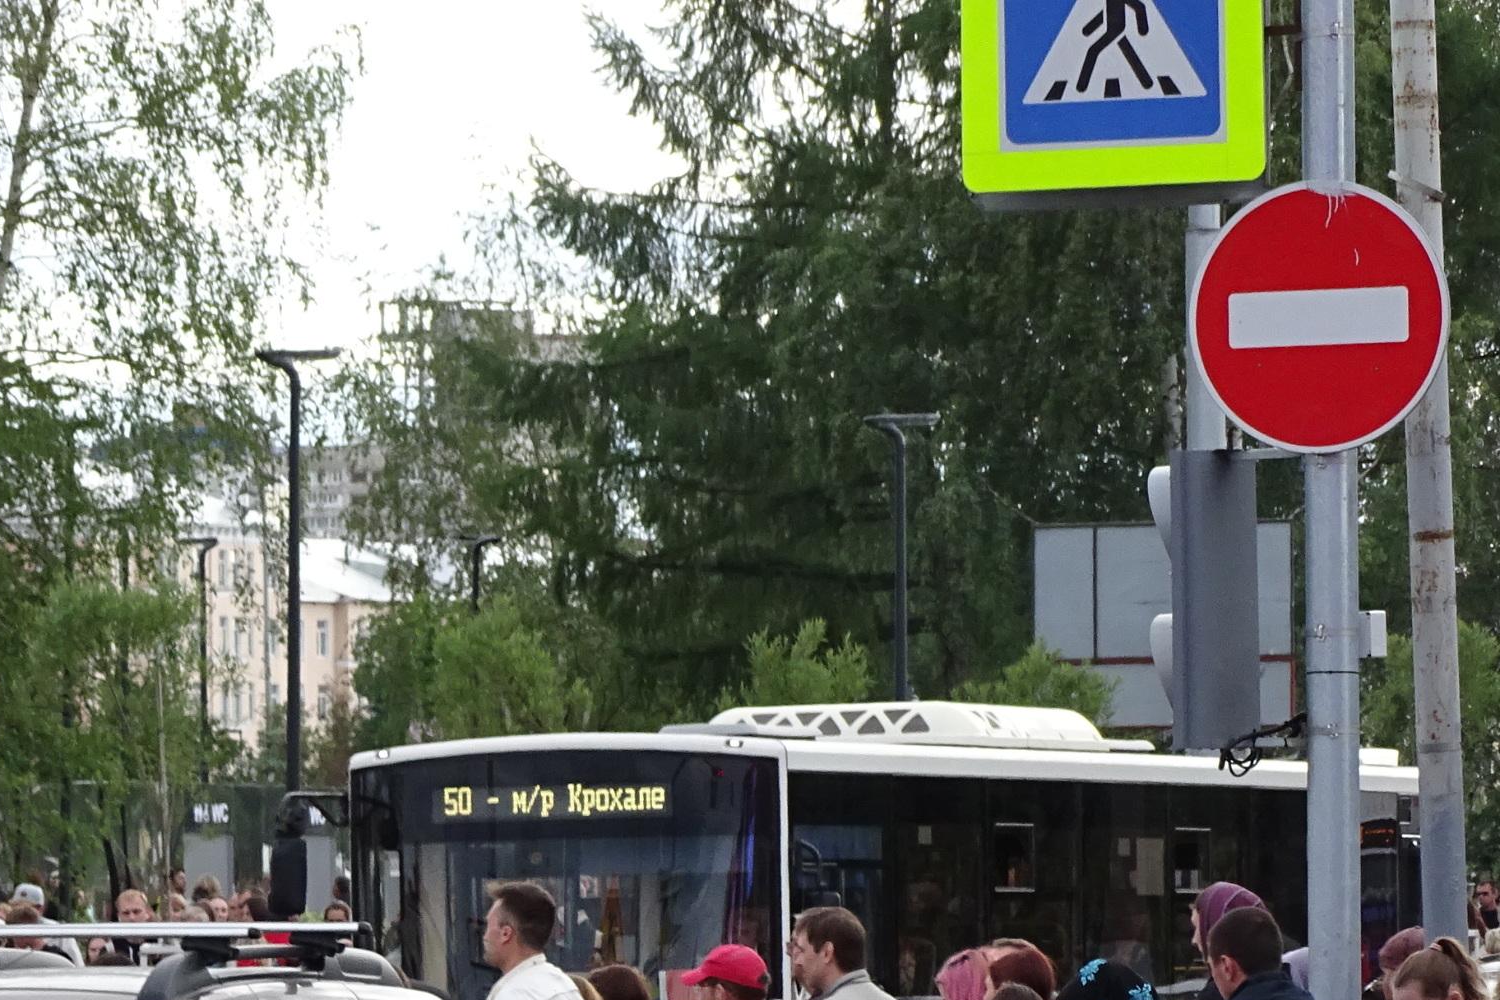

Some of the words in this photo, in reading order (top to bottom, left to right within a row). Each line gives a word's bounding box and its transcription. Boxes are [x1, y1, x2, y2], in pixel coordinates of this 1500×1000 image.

[443, 786, 472, 816] 50
[487, 796, 500, 805] -
[512, 784, 555, 818] м/р
[567, 783, 667, 817] Крохале
